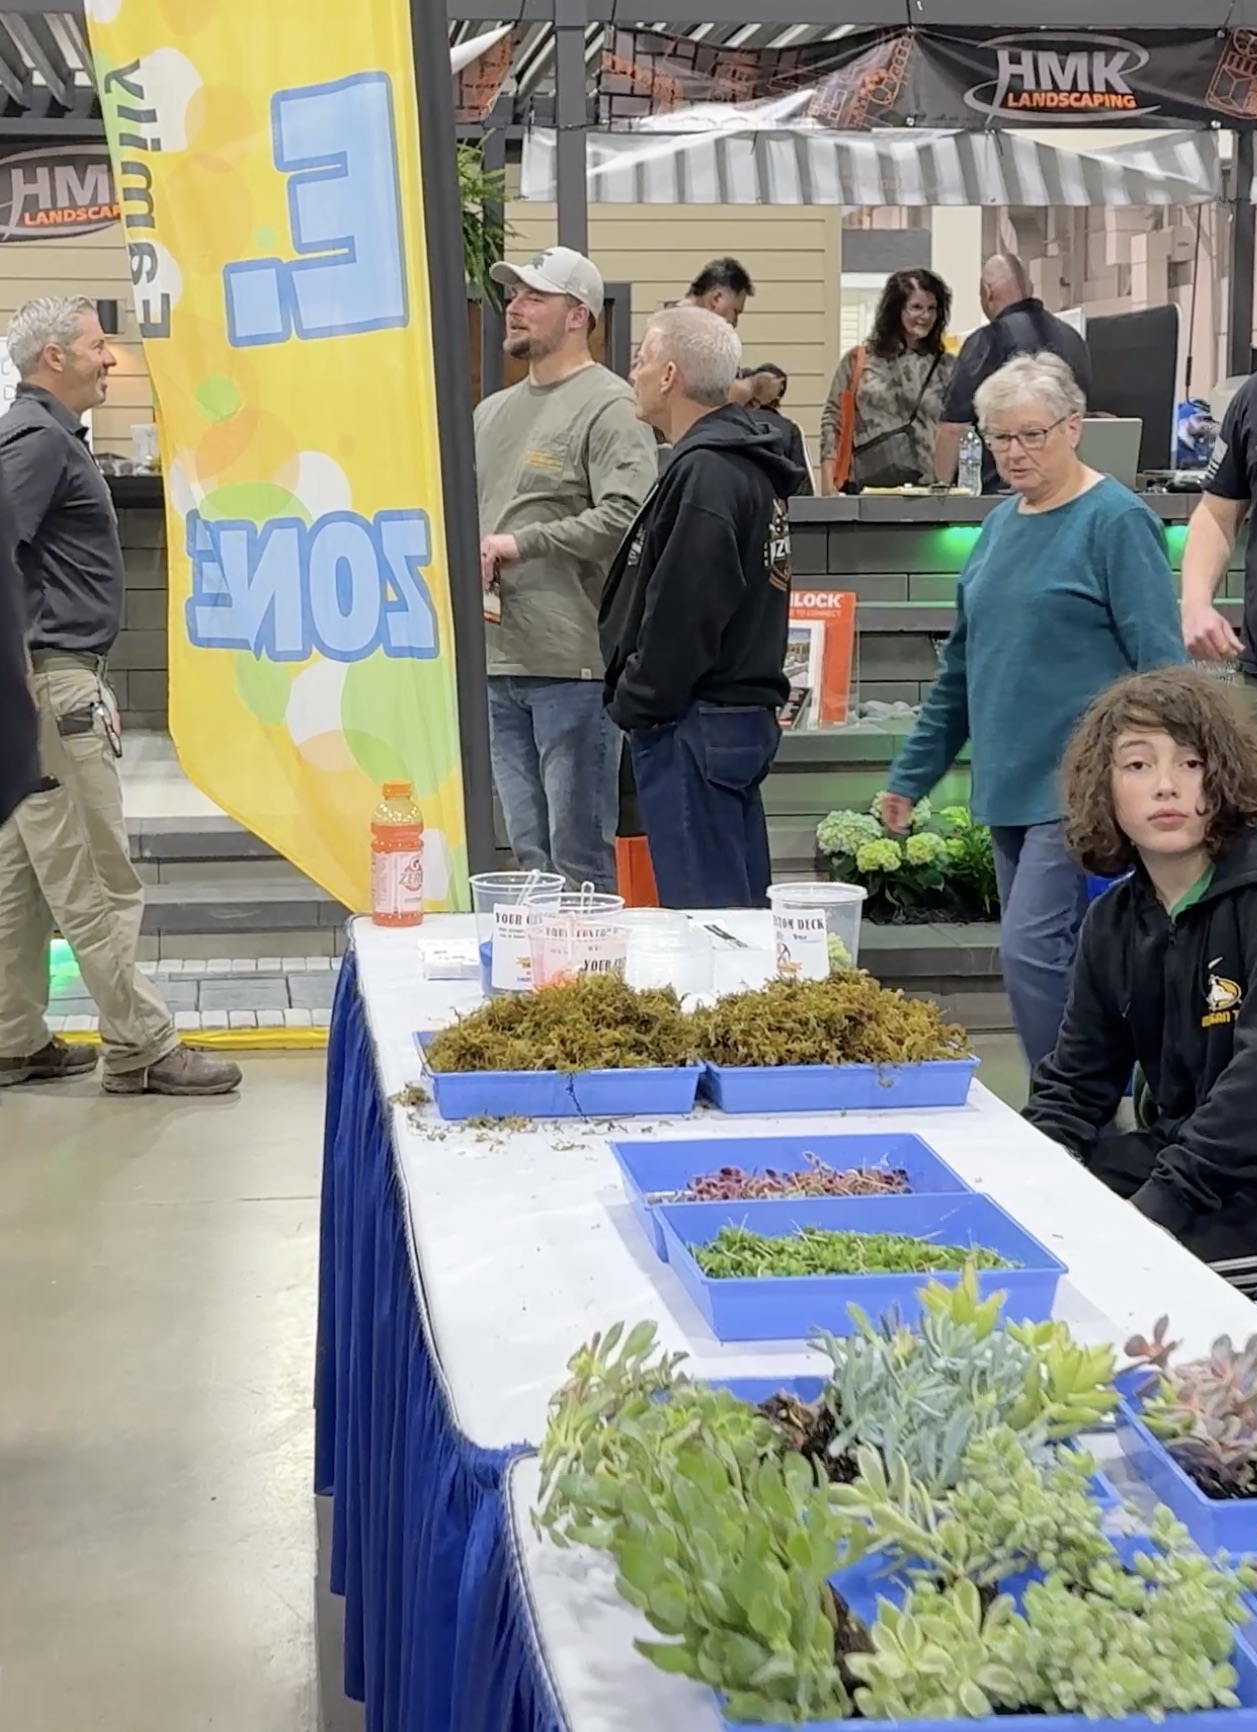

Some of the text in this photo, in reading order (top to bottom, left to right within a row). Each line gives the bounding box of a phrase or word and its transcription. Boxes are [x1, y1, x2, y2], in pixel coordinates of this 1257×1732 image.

[996, 50, 1132, 93] HMK
[1007, 91, 1137, 110] LANDSCAPING
[10, 164, 110, 218] HM
[24, 204, 121, 226] LANDSCAP
[495, 912, 523, 925] YOUR
[797, 919, 825, 930] DECK
